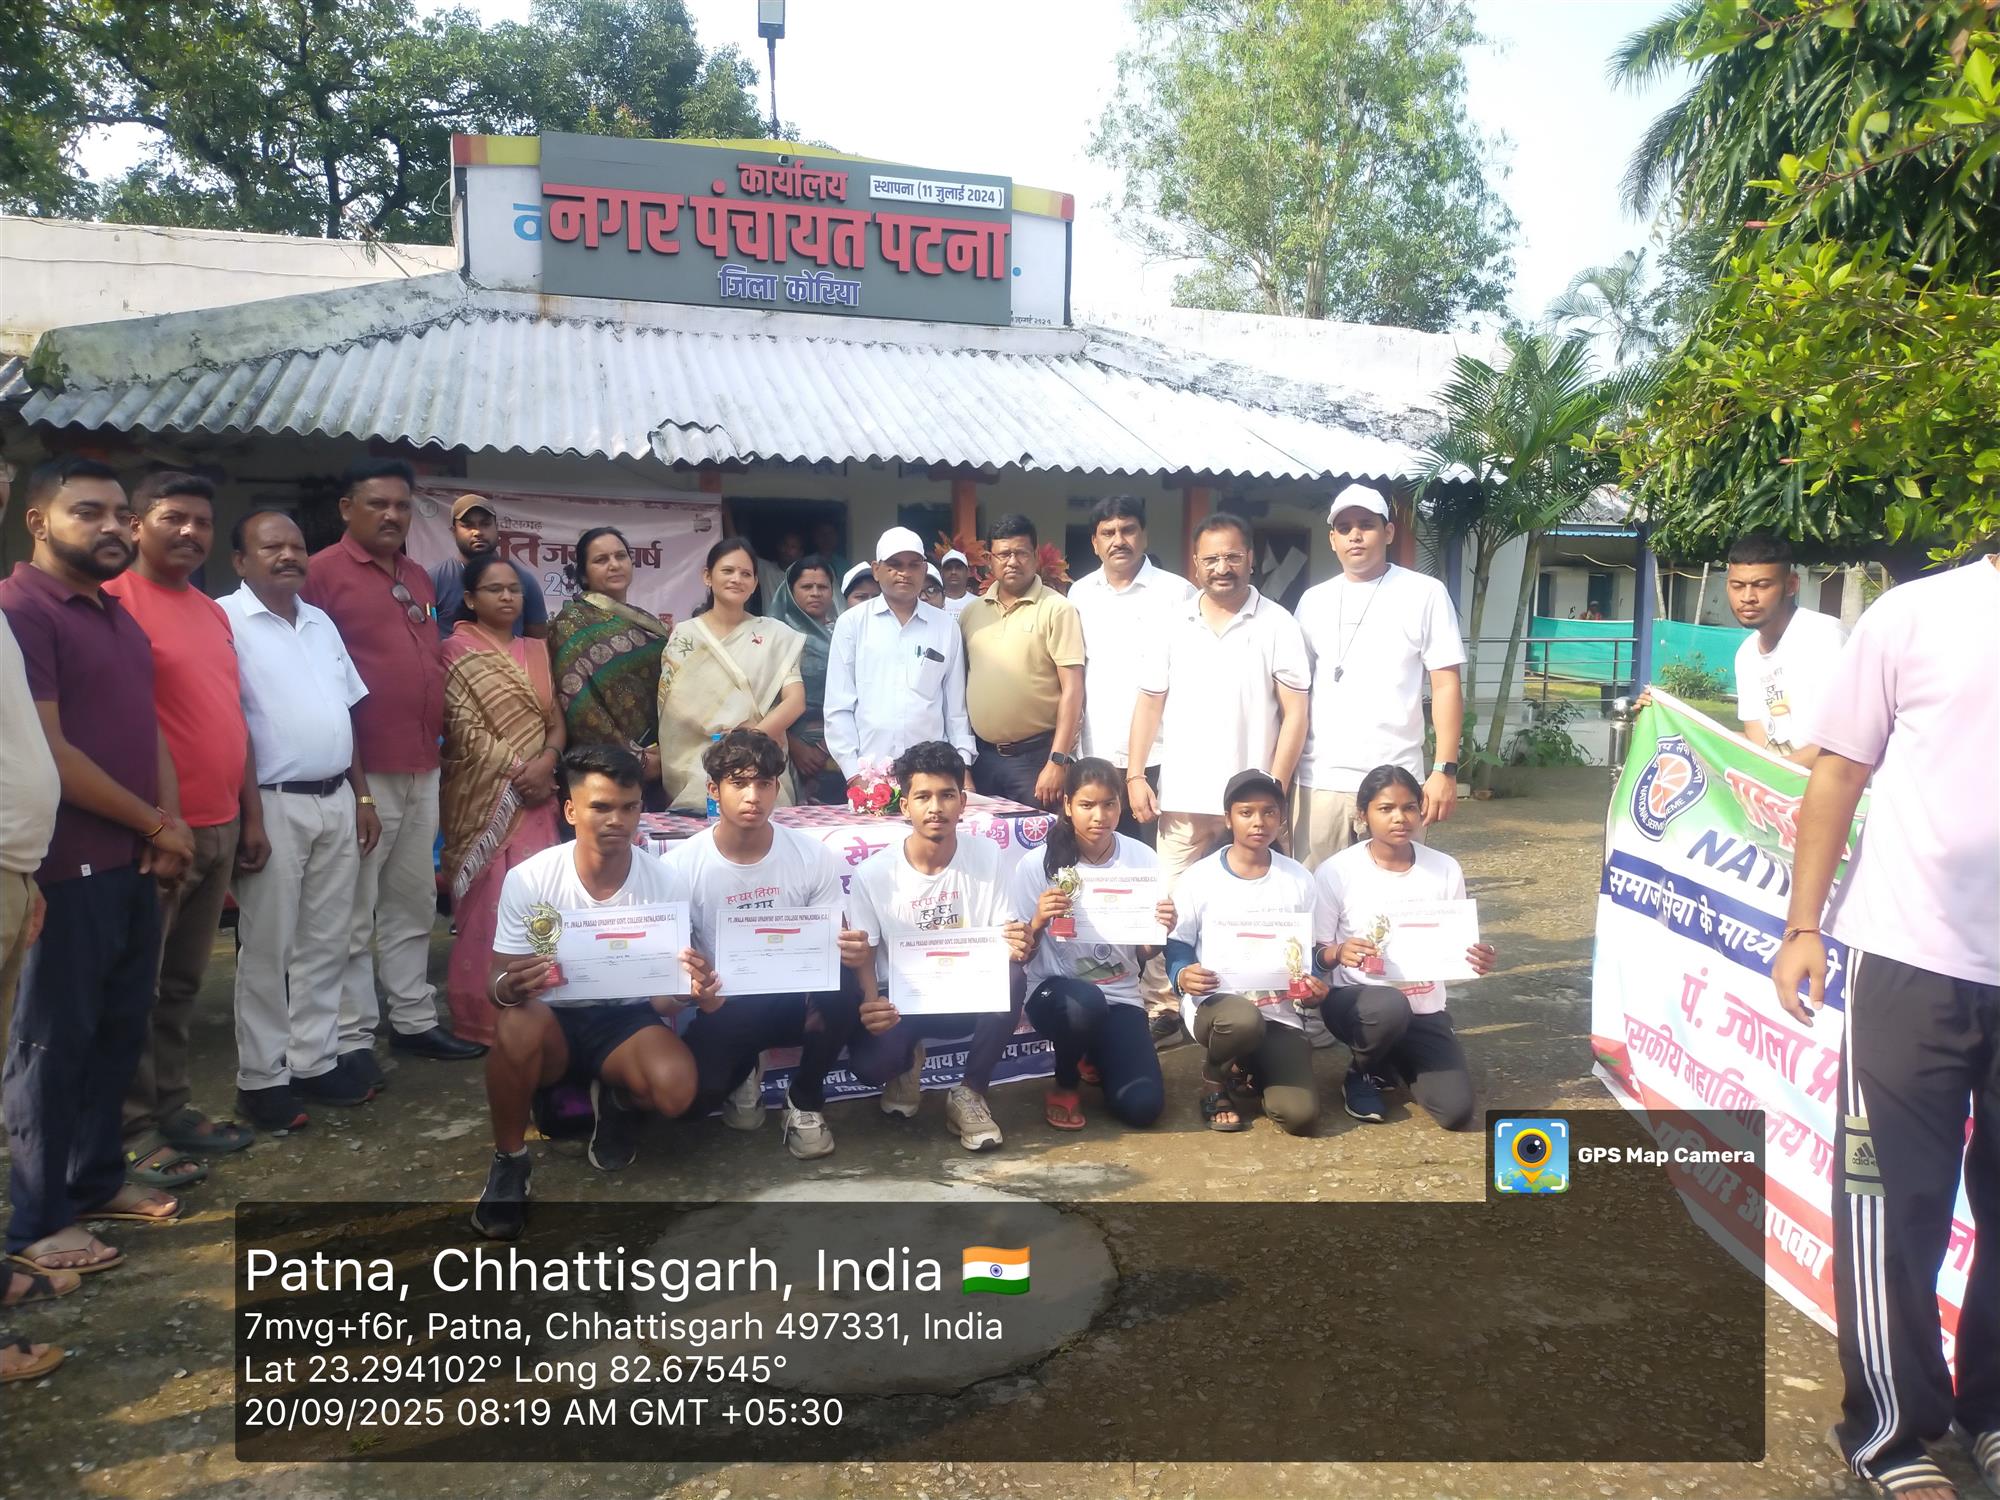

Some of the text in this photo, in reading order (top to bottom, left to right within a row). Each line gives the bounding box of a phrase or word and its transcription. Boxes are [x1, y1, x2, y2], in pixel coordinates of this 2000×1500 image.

[738, 160, 848, 201] कार्यालय
[873, 179, 914, 196] स्थापना
[935, 184, 964, 203] जुलाई
[967, 188, 995, 203] 2024
[542, 183, 685, 255] नगर
[689, 178, 872, 270] पंचायत
[875, 212, 1011, 280] पटना
[718, 263, 862, 307] जिला कोरिया
[1697, 894, 1717, 936] के
[1716, 992, 1816, 1085] ज्वाला
